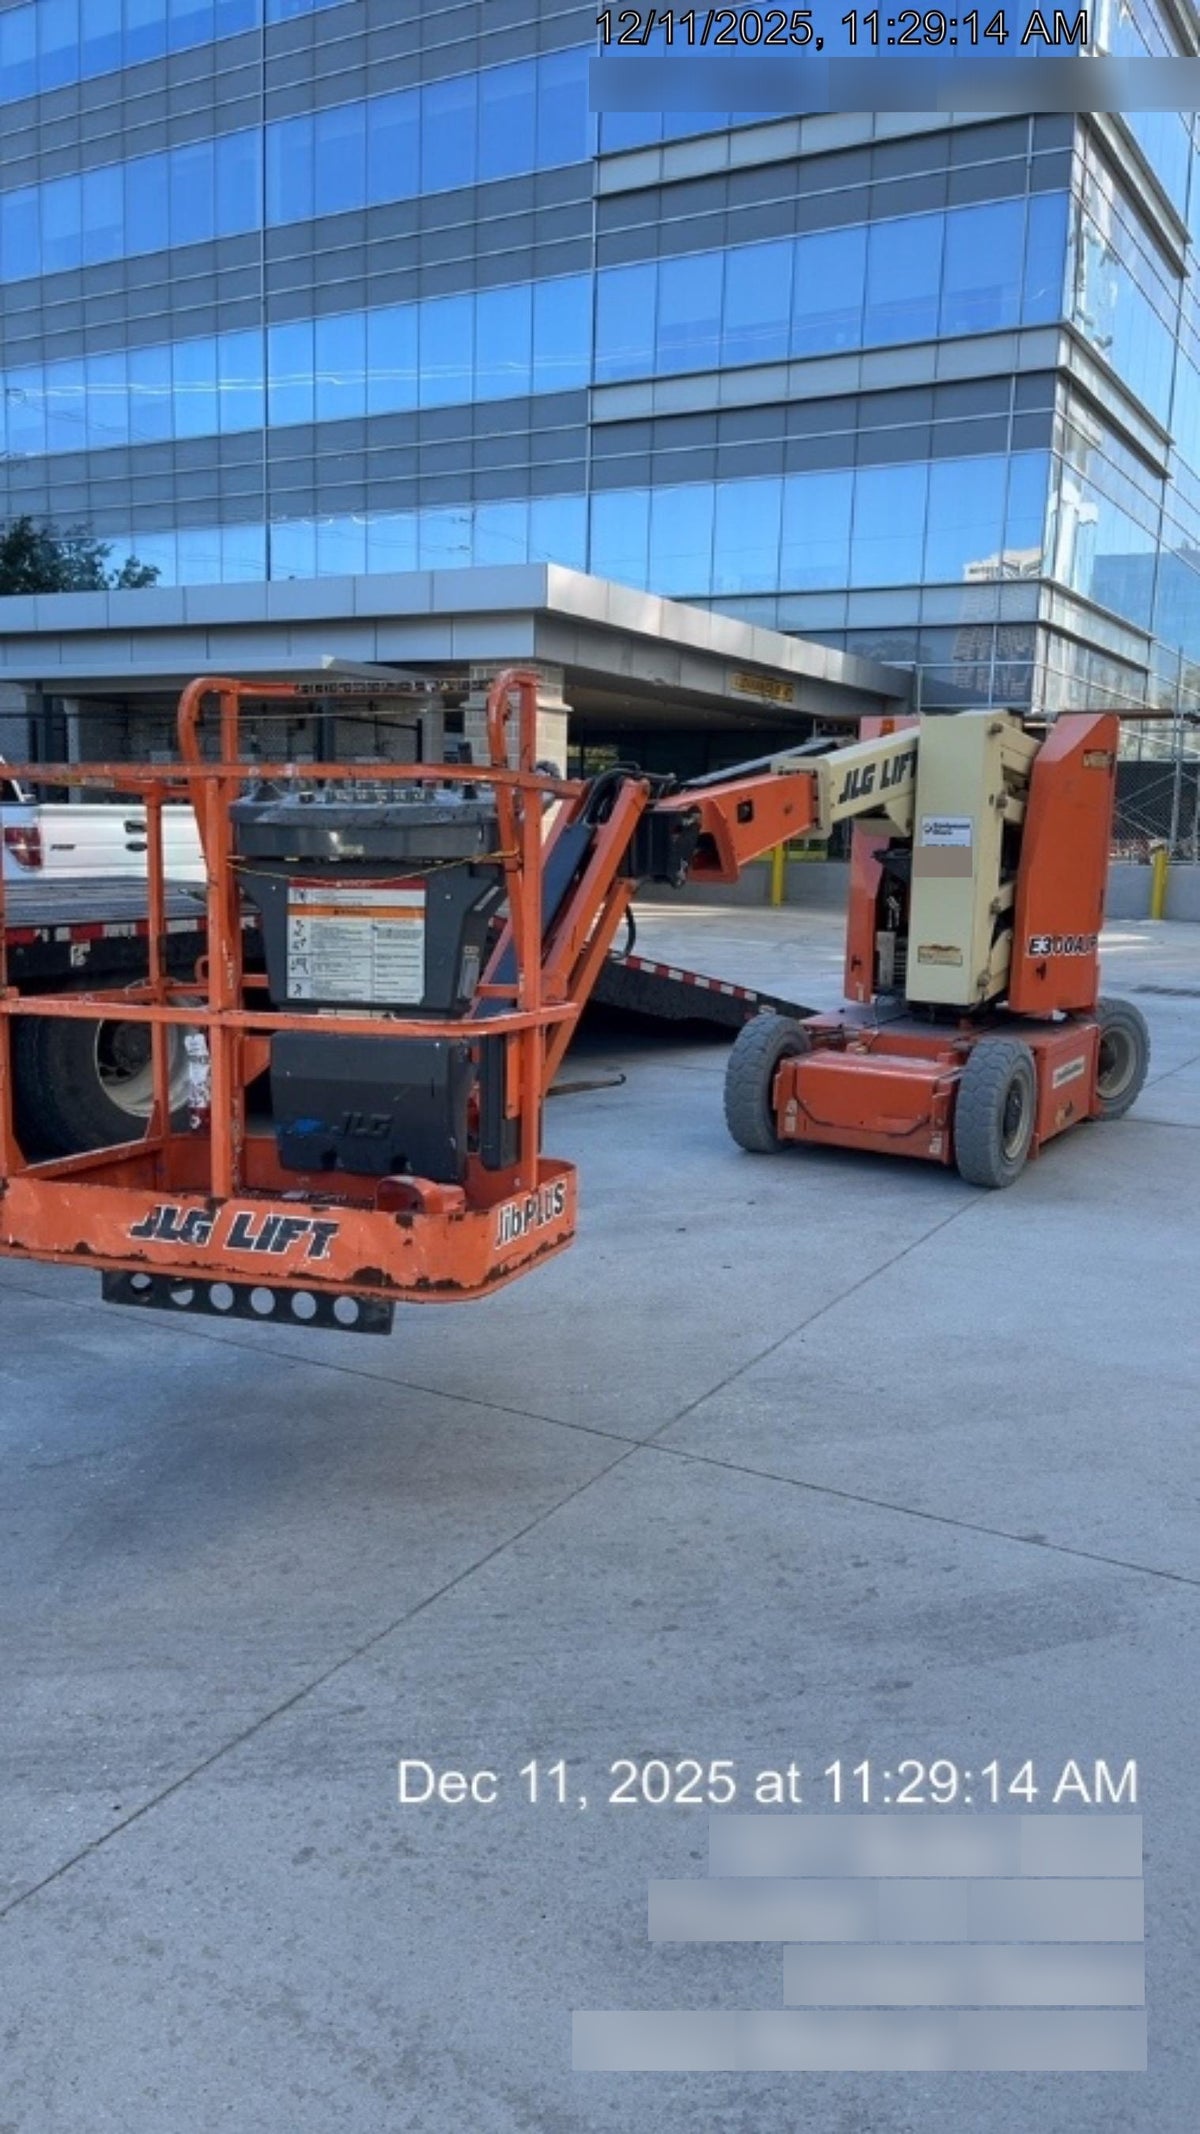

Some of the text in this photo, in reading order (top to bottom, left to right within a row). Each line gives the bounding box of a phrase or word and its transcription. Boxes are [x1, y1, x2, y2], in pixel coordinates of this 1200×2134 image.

[838, 749, 918, 804] JLG LIFT
[128, 1203, 340, 1261] JLG LIFT
